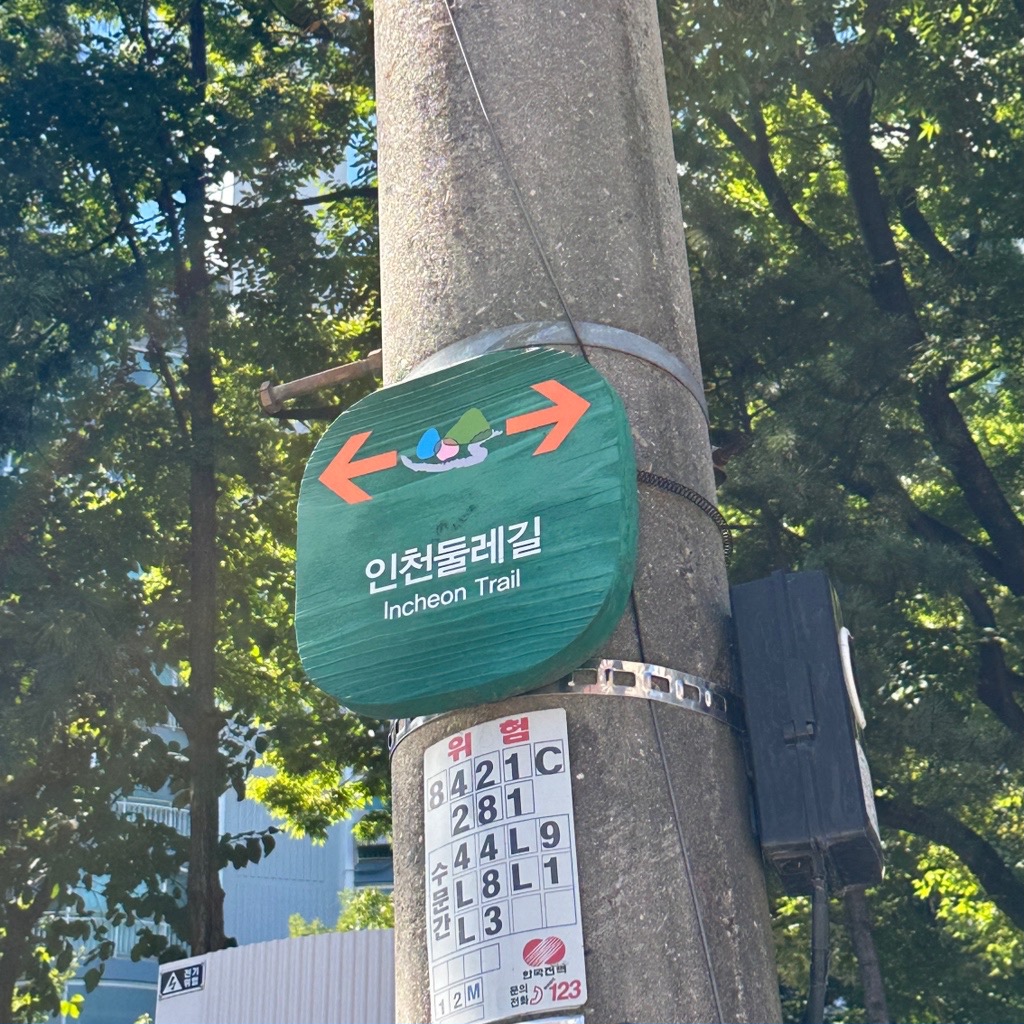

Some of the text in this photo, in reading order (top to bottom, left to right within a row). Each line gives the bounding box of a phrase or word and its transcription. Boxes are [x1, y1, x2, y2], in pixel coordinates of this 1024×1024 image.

[365, 516, 542, 594] 인천둘레길
[383, 568, 521, 620] Incheon Trail
[451, 787, 522, 836] 281
[549, 979, 582, 1002] 123
